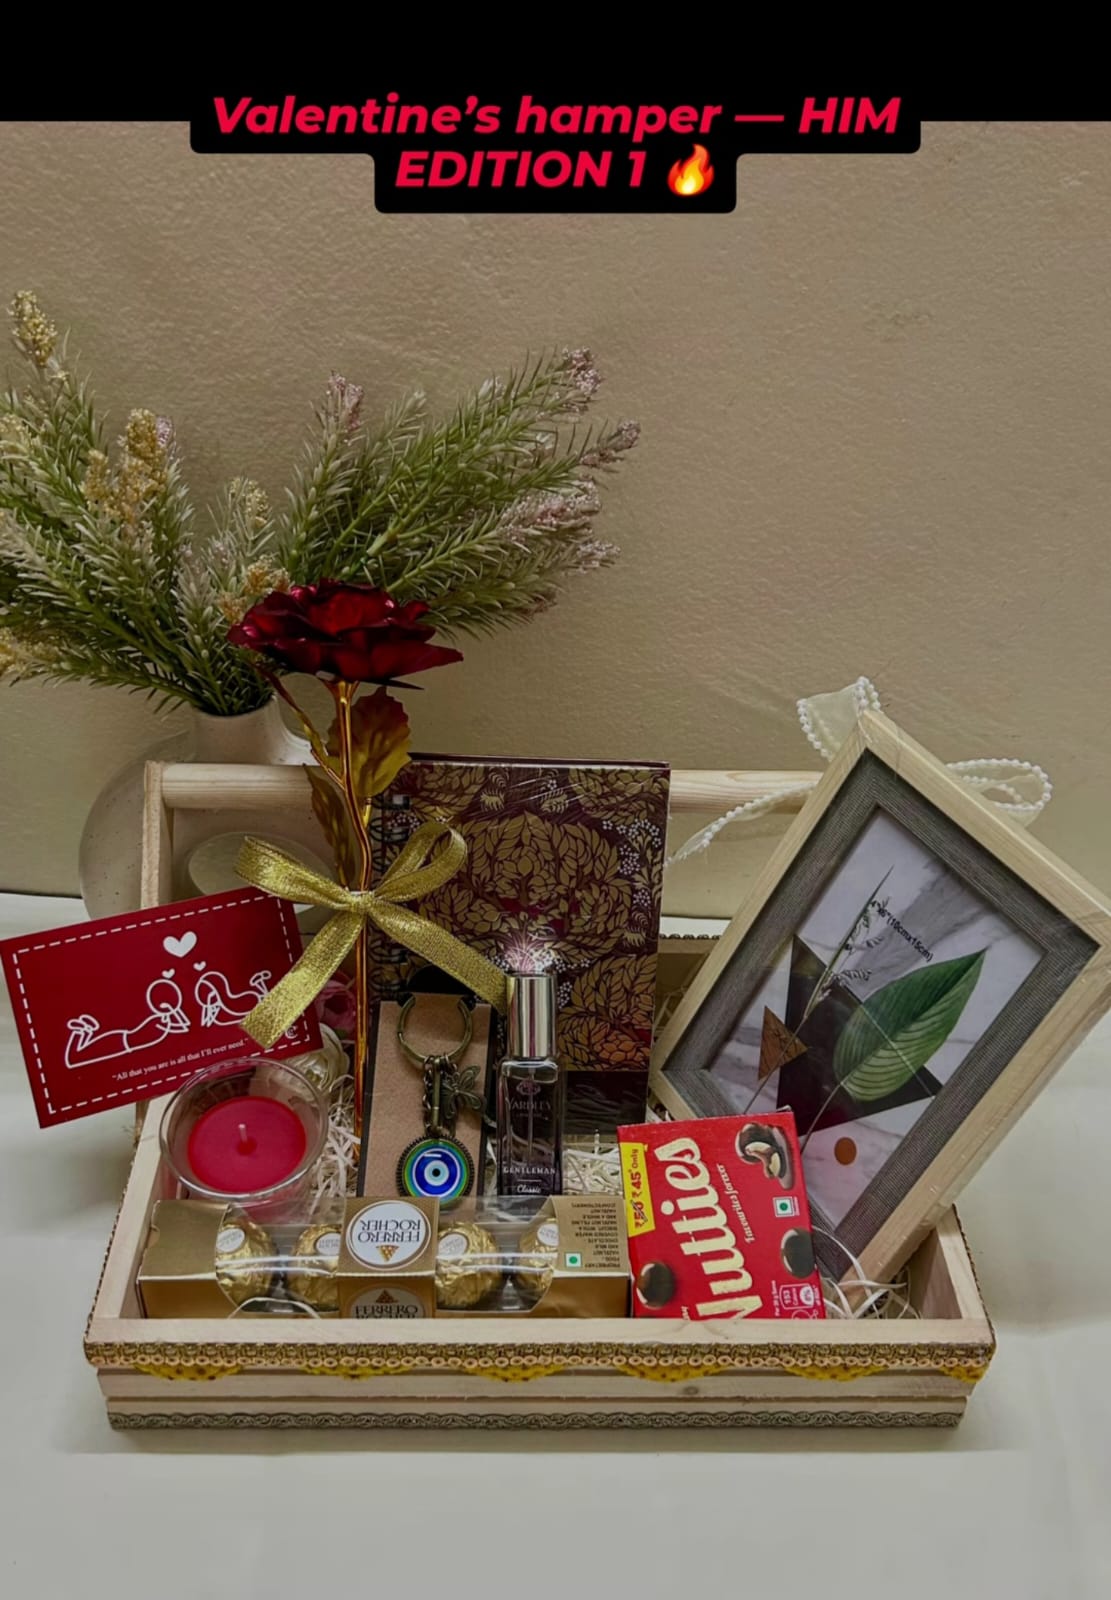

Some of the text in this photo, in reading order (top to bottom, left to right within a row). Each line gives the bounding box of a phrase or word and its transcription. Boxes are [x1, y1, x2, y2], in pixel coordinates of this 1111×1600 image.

[129, 1069, 142, 1077] that
[632, 1149, 640, 1168] Only
[503, 1167, 556, 1175] GENTLEMAN
[517, 1184, 541, 1194] Classic
[360, 1219, 420, 1230] ROCHER
[357, 1231, 419, 1242] FERRERO
[355, 1305, 417, 1313] FERRERO
